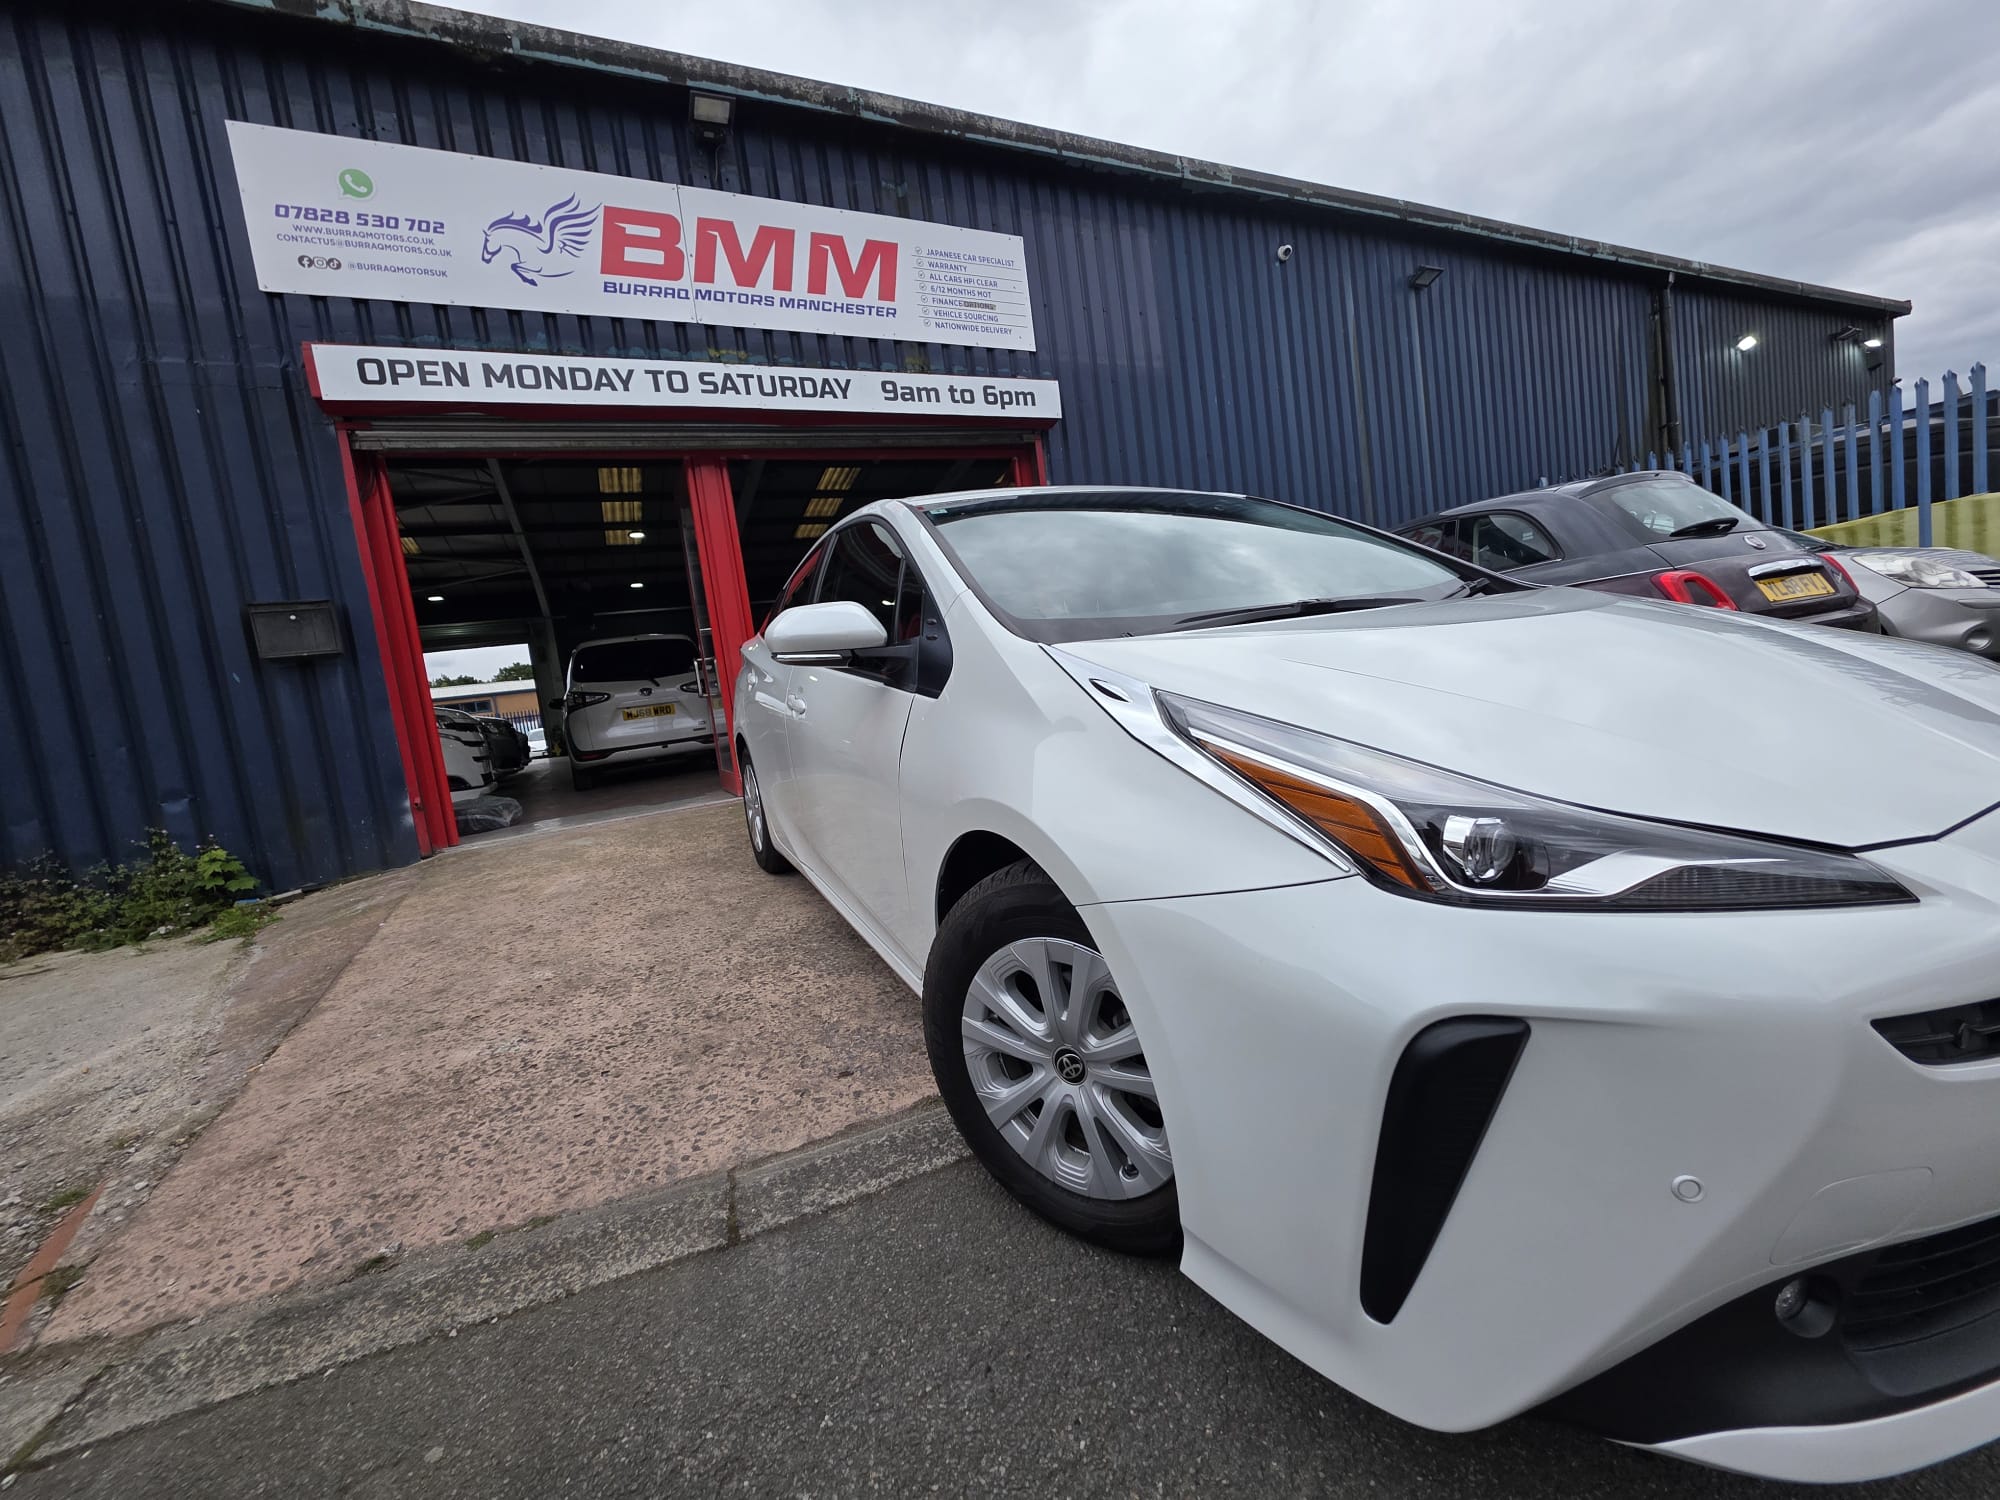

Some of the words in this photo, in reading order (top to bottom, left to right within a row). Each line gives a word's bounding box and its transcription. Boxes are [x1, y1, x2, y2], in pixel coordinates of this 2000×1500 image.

[274, 204, 350, 225] 07828
[356, 213, 399, 230] 530
[404, 218, 445, 235] 702
[292, 224, 435, 246] WWW.BURRAQMOTORS.CO.UK
[600, 205, 899, 303] BMM
[926, 248, 961, 260] JAPANESE
[962, 253, 977, 262] CAR
[978, 255, 1015, 267] SPECIALIST
[927, 261, 967, 272] WARRANTY
[929, 273, 942, 281] ALL
[943, 275, 962, 284] CARS
[963, 277, 975, 285] HPI
[976, 278, 998, 288] CLEAR
[603, 281, 690, 301] BURRAQ
[695, 289, 776, 307] MOTORS
[779, 297, 897, 319] MANCHESTER
[930, 285, 945, 293] 6/12
[947, 287, 976, 297] MONTHS
[977, 290, 991, 298] MOT
[932, 297, 962, 307] FINANCE
[933, 310, 962, 319] VEHICLE
[964, 311, 998, 322] SOURCING
[935, 321, 979, 332] NATIONWIDE
[980, 325, 1012, 335] DELIVERY
[356, 357, 470, 387] OPEN
[481, 362, 634, 392] MONDAY
[643, 369, 689, 394] TO
[698, 372, 852, 400] SATURDAY
[881, 380, 941, 403] 9am
[948, 383, 975, 404] to
[983, 385, 1036, 410] 6pm
